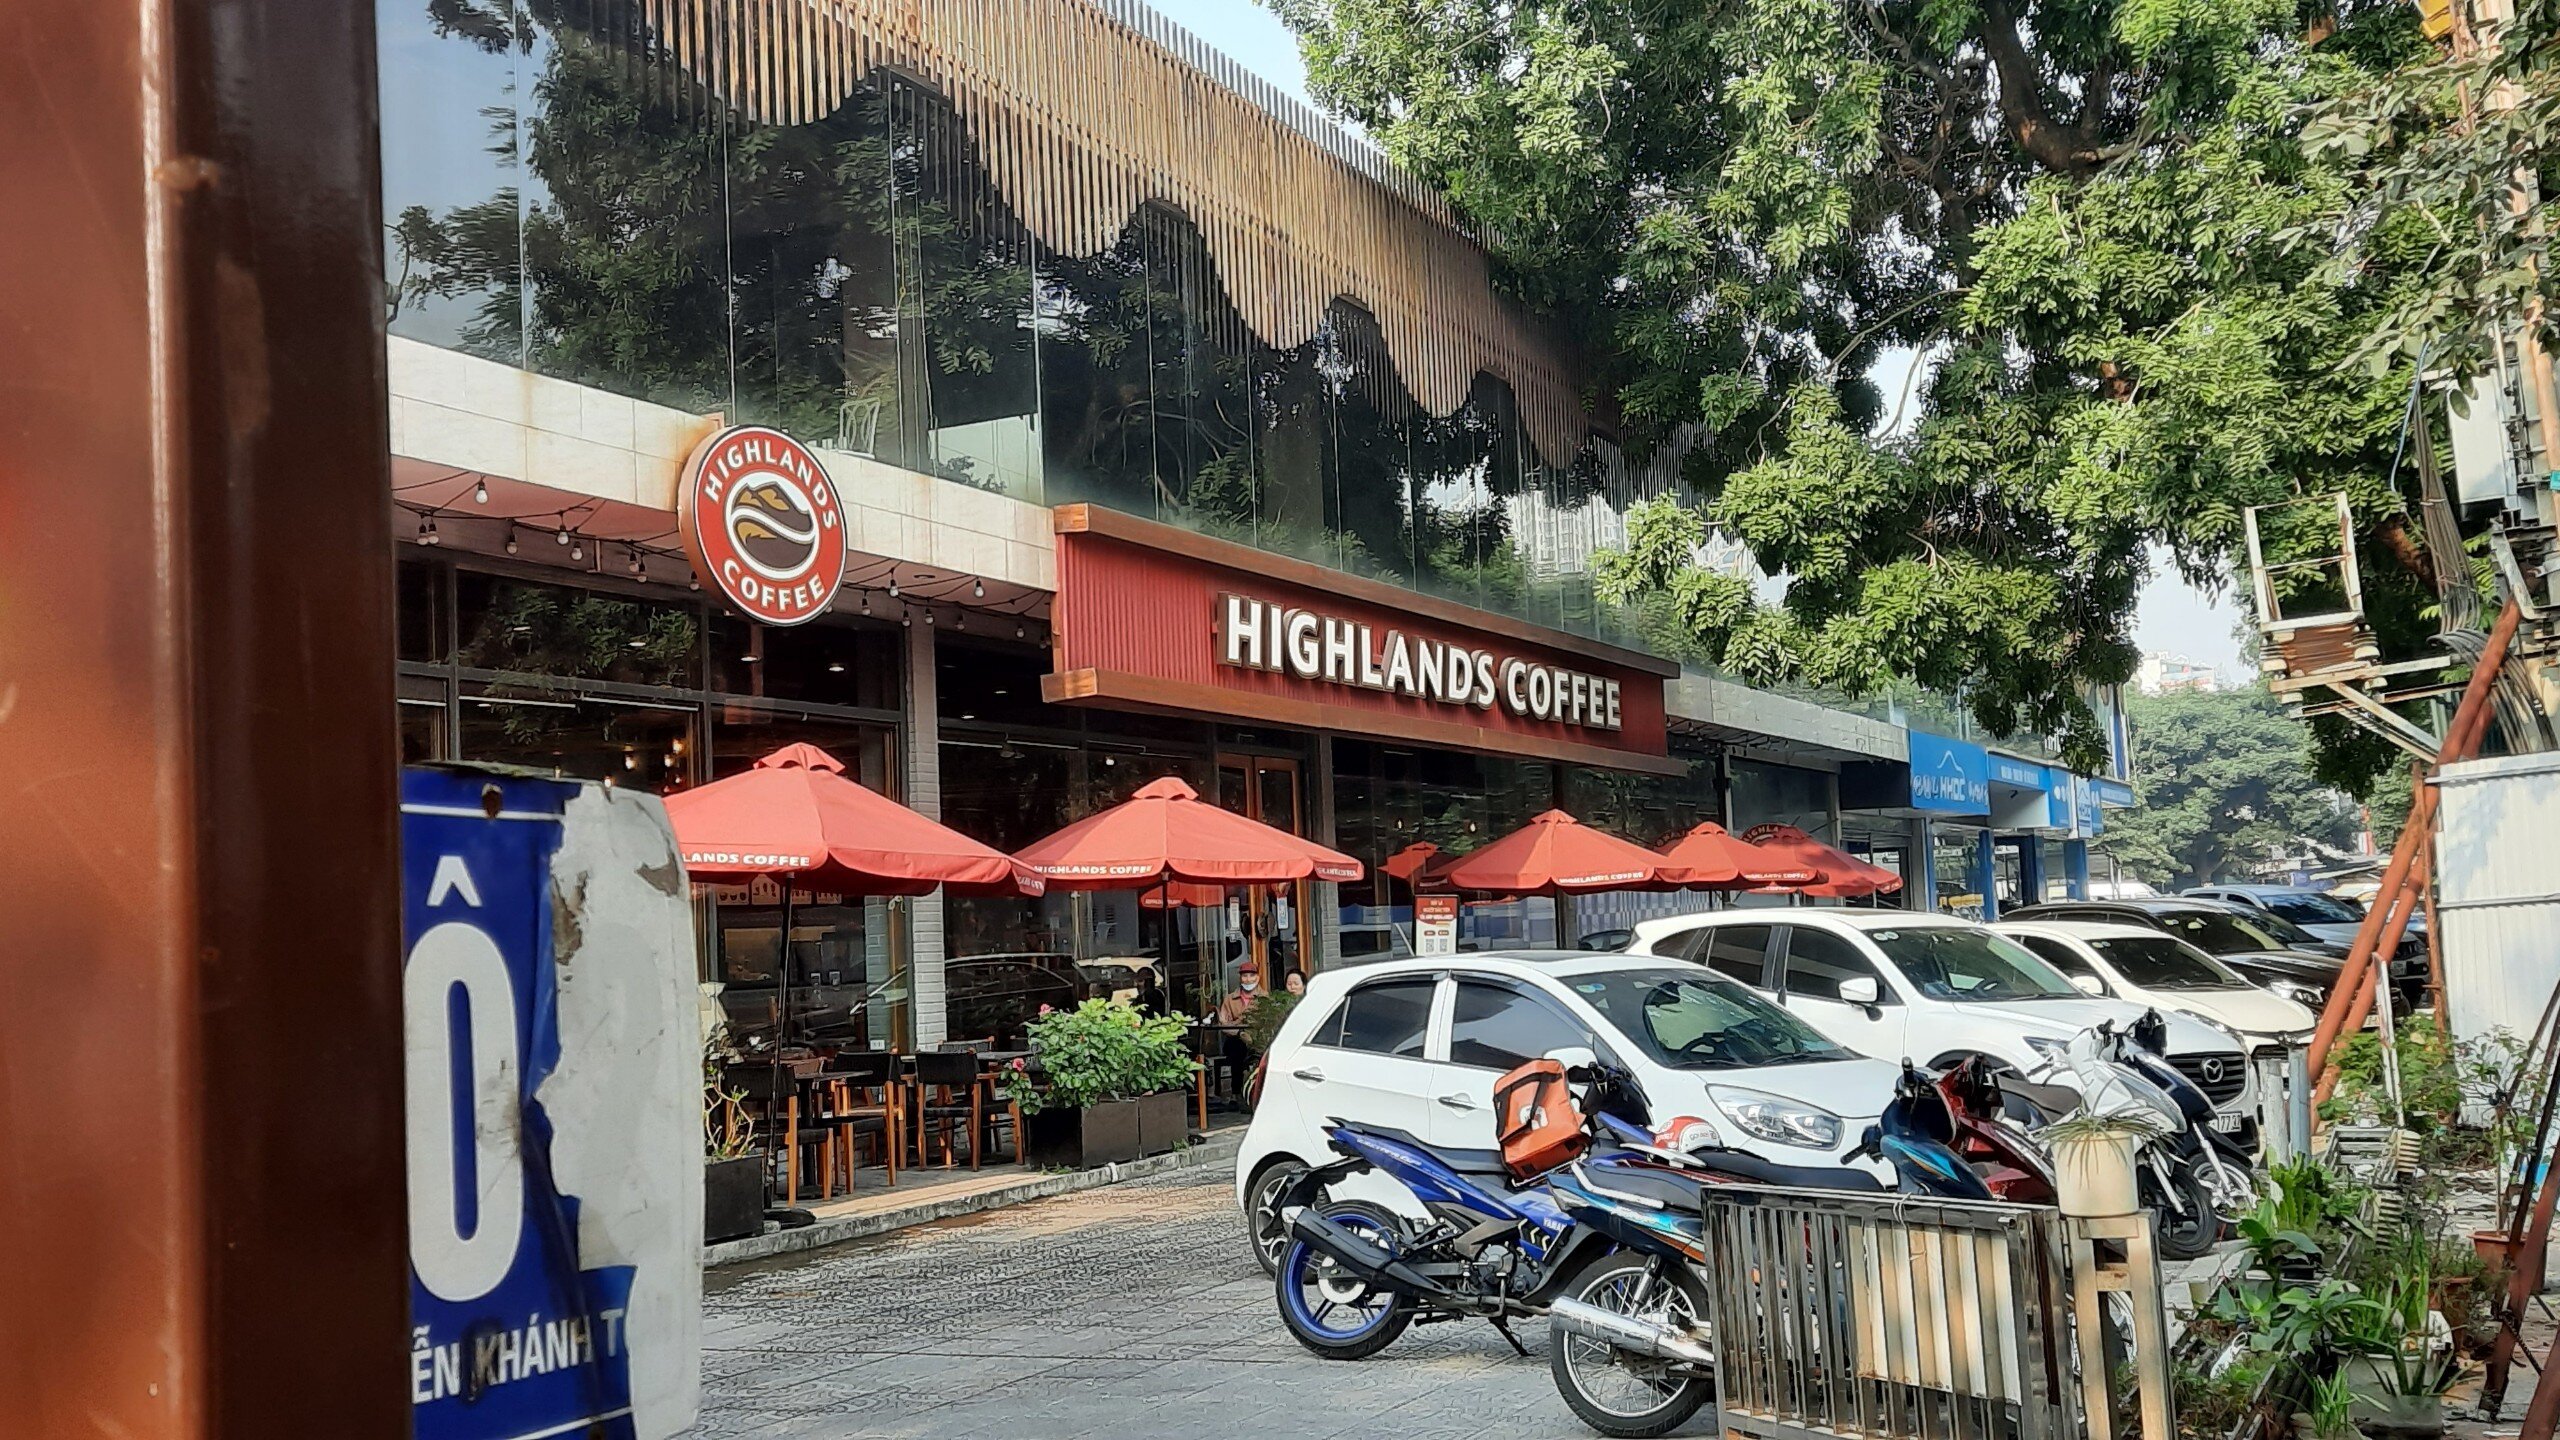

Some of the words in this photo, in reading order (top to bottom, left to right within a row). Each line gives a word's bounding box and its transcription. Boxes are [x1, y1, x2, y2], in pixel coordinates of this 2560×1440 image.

[704, 438, 838, 529] HIGHLANDS
[723, 557, 826, 612] COFFEE
[1223, 593, 1497, 710] HIGHLANDS
[1505, 657, 1622, 731] COFFEE
[743, 854, 811, 867] COFFEE
[1034, 865, 1107, 875] HIGHLANDS
[474, 1312, 594, 1387] KHÁNH
[600, 1308, 624, 1357] T
